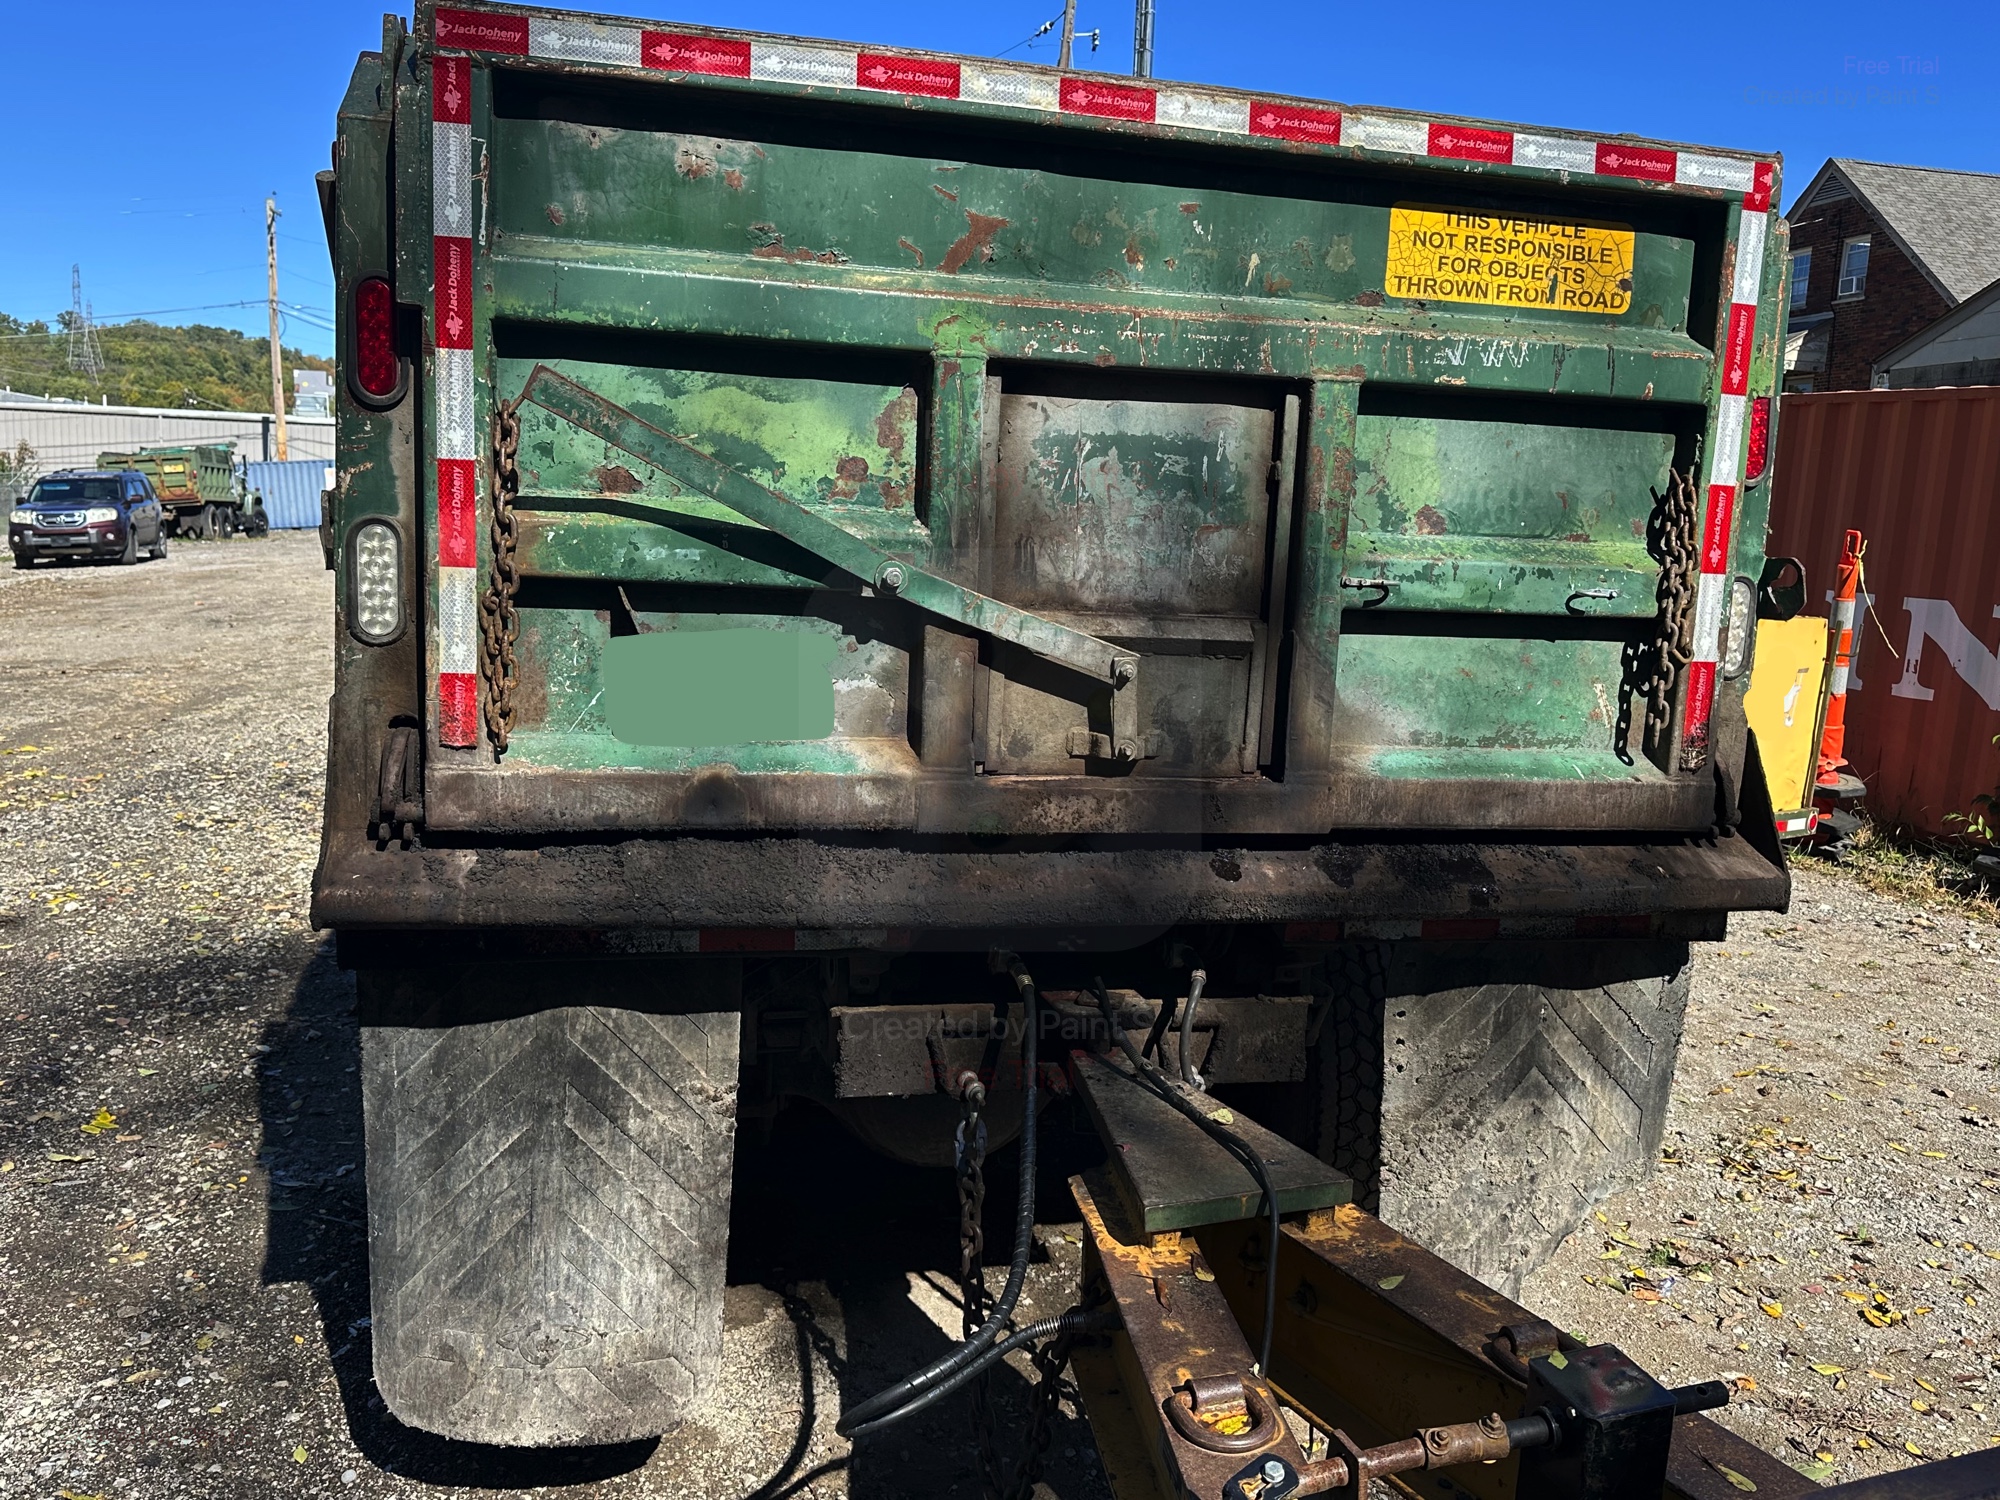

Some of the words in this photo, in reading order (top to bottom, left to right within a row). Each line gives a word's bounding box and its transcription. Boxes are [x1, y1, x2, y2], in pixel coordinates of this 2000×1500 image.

[452, 24, 477, 35] Jack
[477, 26, 522, 42] Doheny
[567, 37, 591, 48] Jack
[592, 39, 635, 54] Doheny
[679, 48, 702, 60] Jack
[702, 51, 745, 66] Doheny
[447, 61, 456, 85] Jack
[787, 61, 810, 71] Jack
[810, 62, 851, 77] Doheny
[892, 71, 914, 82] Jack
[914, 73, 954, 88] Doheny
[1092, 95, 1113, 105] Jack
[1114, 97, 1150, 112] Doheny
[1280, 117, 1300, 128] Jack
[1300, 120, 1335, 133] Doheny
[447, 130, 460, 173] Doheny
[1457, 138, 1475, 148] Jack
[1476, 141, 1509, 154] Doheny
[1623, 158, 1640, 167] Jack
[1641, 159, 1672, 172] Doheny
[448, 175, 457, 199] Jack
[1443, 210, 1490, 230] THIS
[1497, 215, 1587, 240] VEHICLE
[1412, 231, 1458, 250] NOT
[1464, 234, 1613, 264] RESPONSIBLE
[448, 243, 460, 287] Doheny
[1438, 256, 1481, 275] FOR
[449, 288, 457, 311] Jack
[1394, 276, 1490, 299] THROWN
[1562, 289, 1624, 309] ROAD
[1736, 309, 1748, 345] Doheny
[1734, 345, 1743, 365] Jack
[450, 356, 462, 398] Doheny
[450, 398, 459, 421] Jack
[451, 466, 464, 508] Doheny
[1715, 490, 1726, 525] Doheny
[452, 508, 462, 531] Jack
[1713, 525, 1721, 545] Jack
[1696, 667, 1707, 700] Doheny
[1694, 700, 1702, 719] Jack
